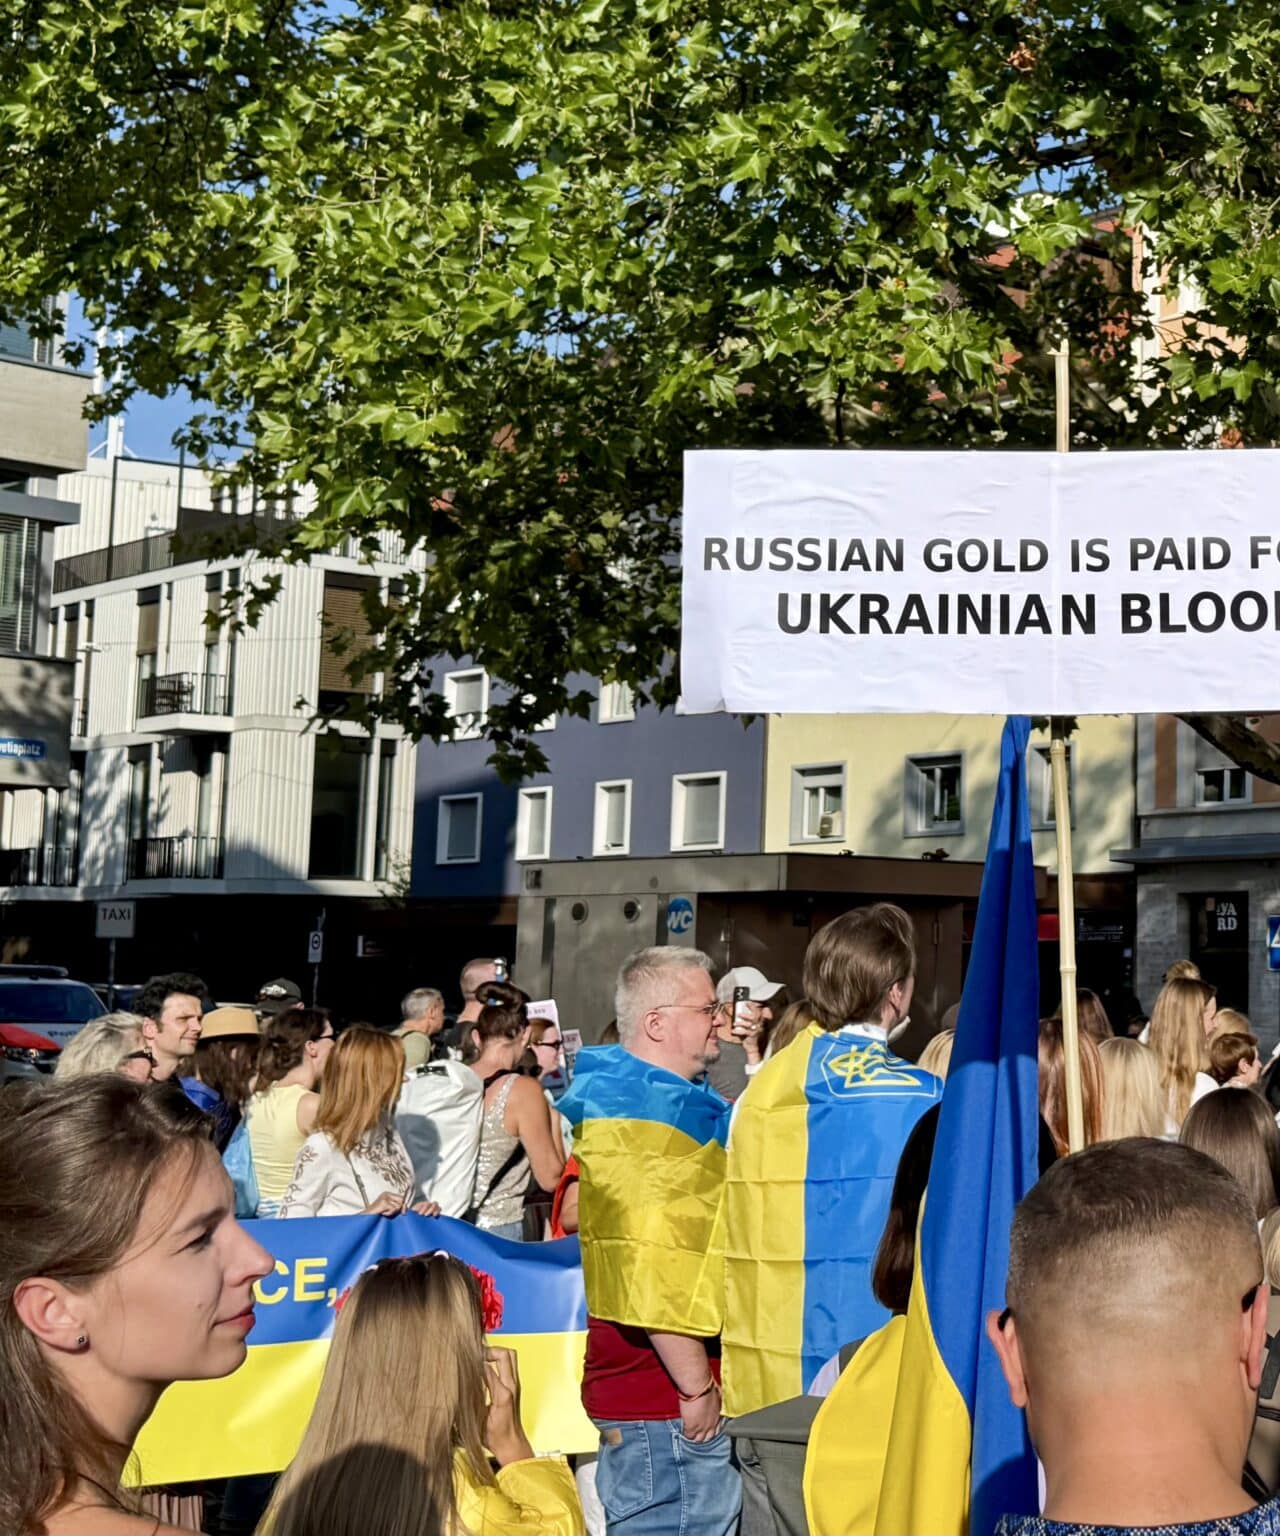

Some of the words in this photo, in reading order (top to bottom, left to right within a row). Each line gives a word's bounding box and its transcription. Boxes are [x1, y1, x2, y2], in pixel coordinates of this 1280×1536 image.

[704, 538, 903, 571] RUSSIAN
[924, 538, 1048, 572] GOLD
[1072, 538, 1110, 572] IS
[1130, 537, 1230, 571] PAID
[778, 593, 1095, 635] UKRAINIAN
[102, 907, 131, 920] TAXI
[667, 910, 692, 929] WC
[1217, 917, 1238, 931] RD
[252, 1257, 338, 1307] CE,
